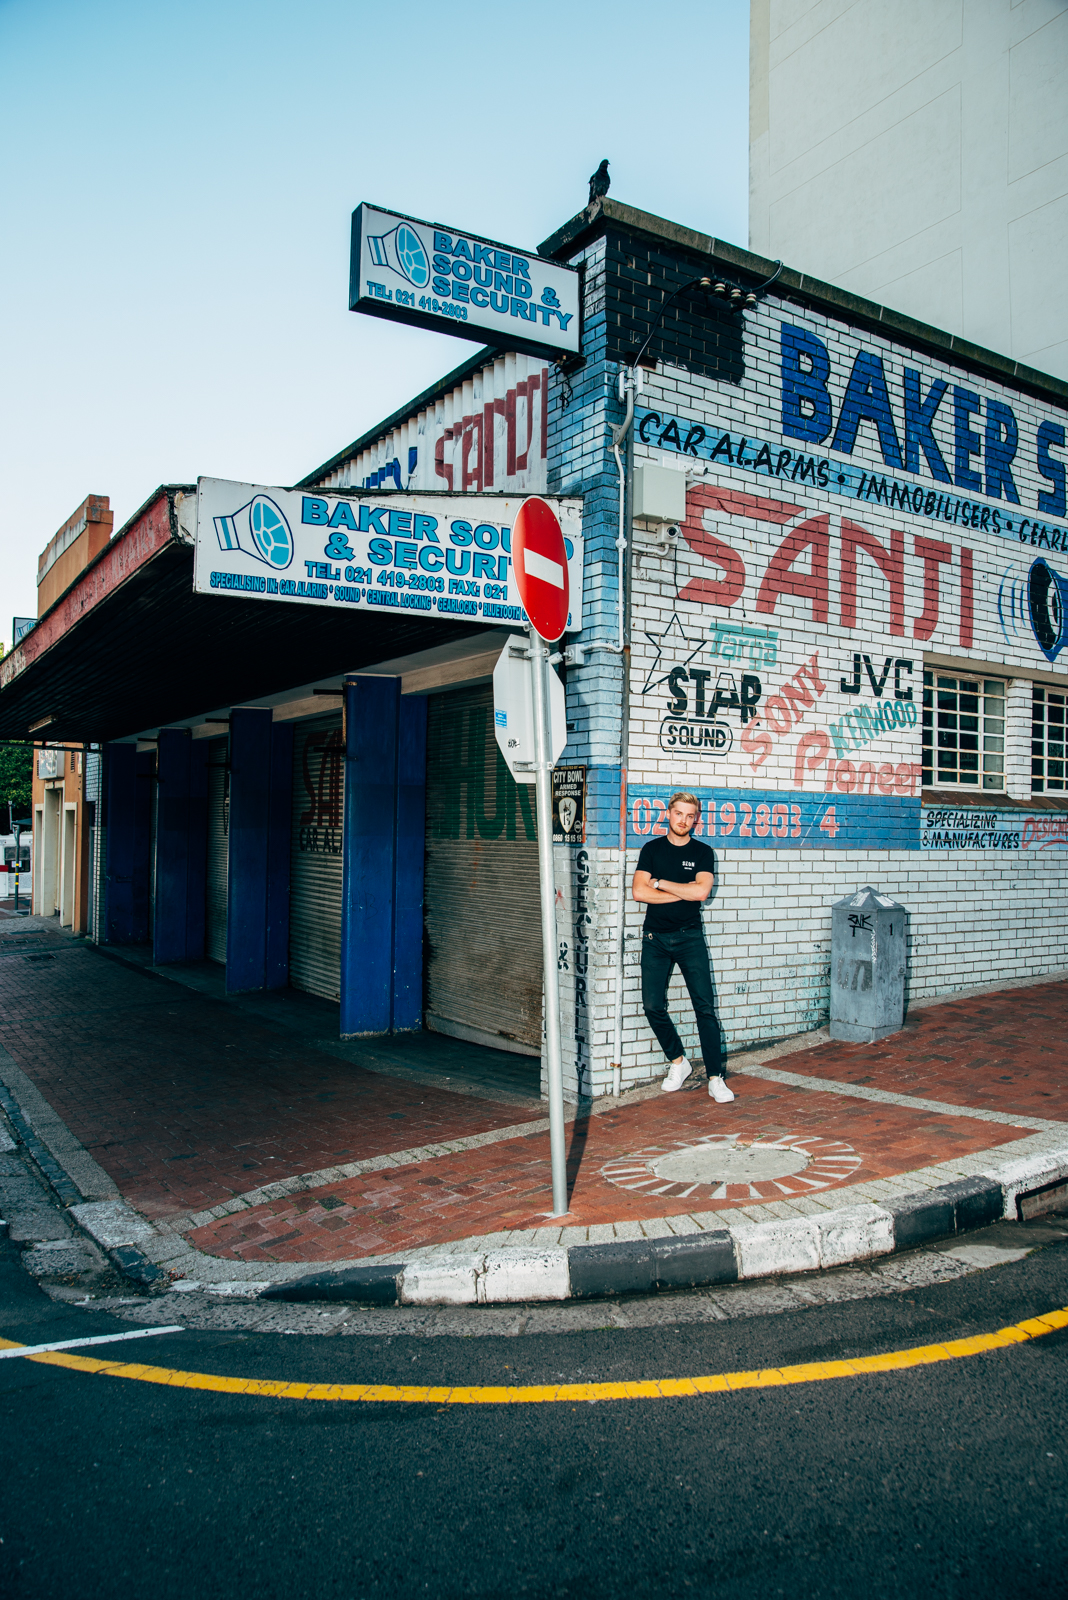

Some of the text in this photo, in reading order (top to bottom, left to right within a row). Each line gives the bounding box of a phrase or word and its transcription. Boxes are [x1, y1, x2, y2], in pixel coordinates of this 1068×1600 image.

[433, 230, 531, 280] BAKER
[367, 280, 468, 320] TEL: 021 419-2803
[432, 254, 533, 299] SOUND
[541, 286, 562, 308] &
[432, 275, 574, 331] SECURITY
[638, 412, 706, 457] CAR
[710, 433, 830, 488] ALARMS
[856, 472, 1001, 534] IMMOBILISERS
[301, 496, 440, 543] BAKER
[304, 561, 508, 601] TEL: 021 419-2803 FAX: 021
[324, 532, 512, 582] & SECURI
[675, 483, 974, 649] SANJI
[210, 571, 266, 593] SPECIALISING
[266, 578, 279, 594] IN:
[279, 579, 298, 595] CAR
[297, 581, 328, 599] ALARMS
[334, 585, 360, 602] SOUND
[367, 589, 400, 608] CENTRAL
[400, 592, 432, 611] LOCKING
[437, 596, 477, 616] GEARLOCKS
[482, 603, 521, 621] BLUETOOTH
[709, 622, 779, 671] Targa
[667, 666, 762, 727] STAR
[840, 653, 913, 701] JVC
[667, 724, 727, 748] SOUND
[740, 650, 827, 773] SONY
[829, 700, 917, 759] KENWOOD
[553, 770, 584, 784] CITY BOWL
[926, 810, 998, 829] SPECIALIZING
